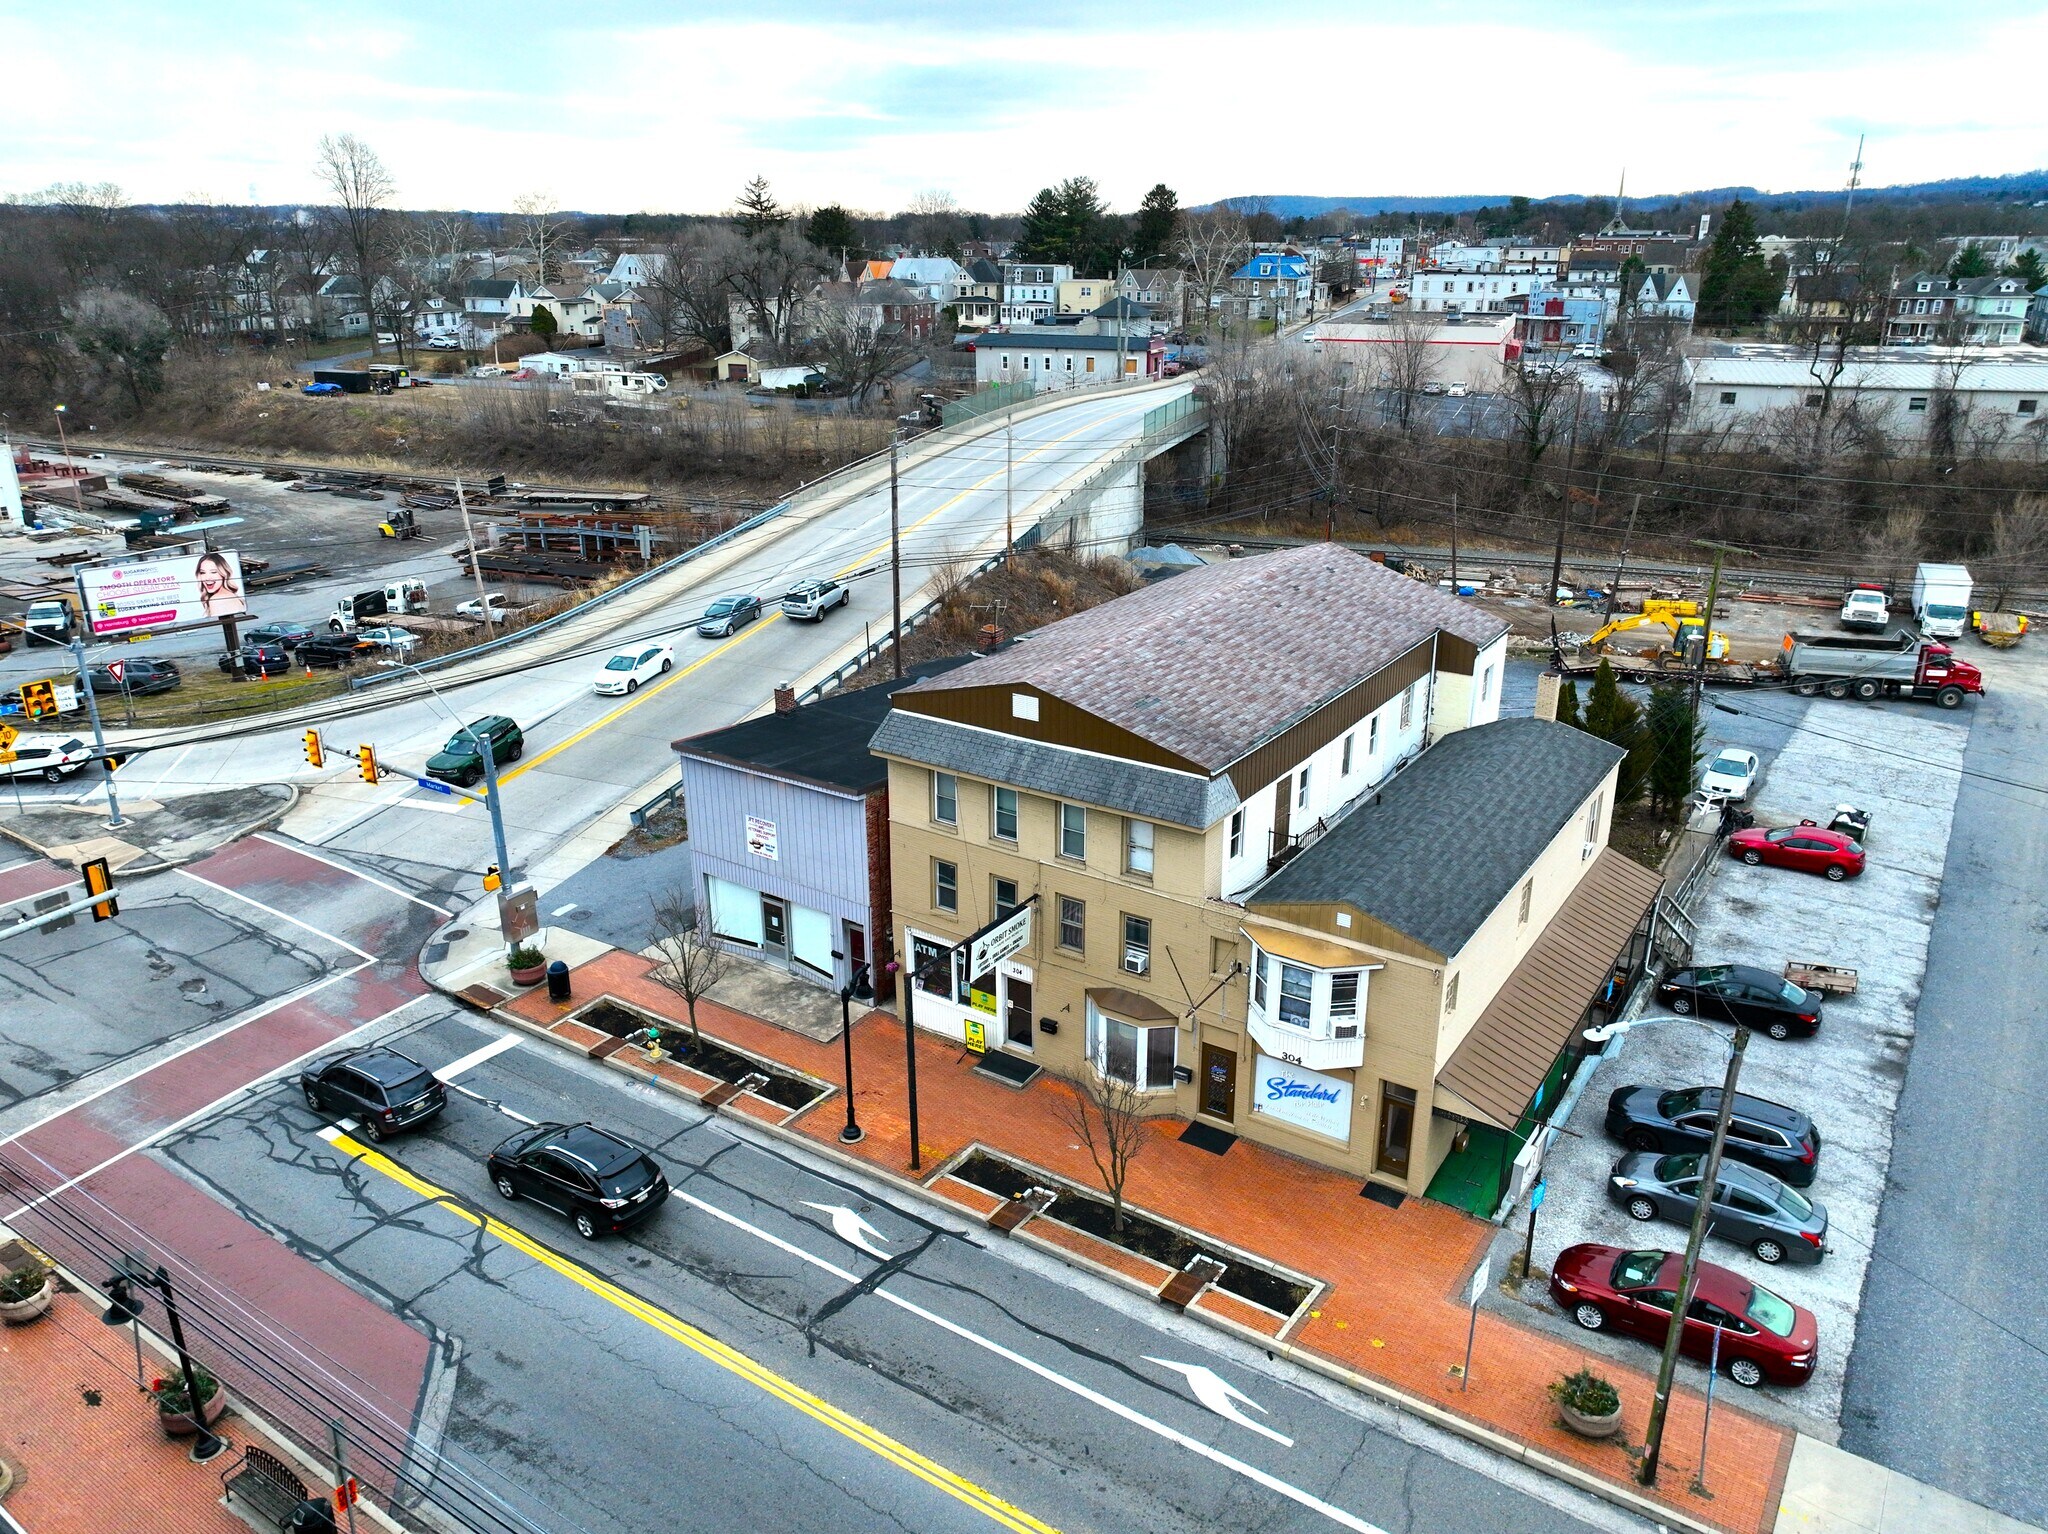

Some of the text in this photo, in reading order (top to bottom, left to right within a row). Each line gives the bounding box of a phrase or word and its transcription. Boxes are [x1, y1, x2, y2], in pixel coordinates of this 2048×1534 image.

[96, 581, 180, 599] CHOOSE SUGAR WAX
[100, 576, 176, 591] SMOOTH OPERATORS
[104, 612, 174, 628] Harrisburg Mechanicsburg
[990, 930, 1008, 946] ORBIT
[1008, 918, 1026, 935] SMOKE
[915, 943, 938, 958] ATM
[1282, 1052, 1302, 1064] 304
[1266, 1077, 1341, 1104] Standard
